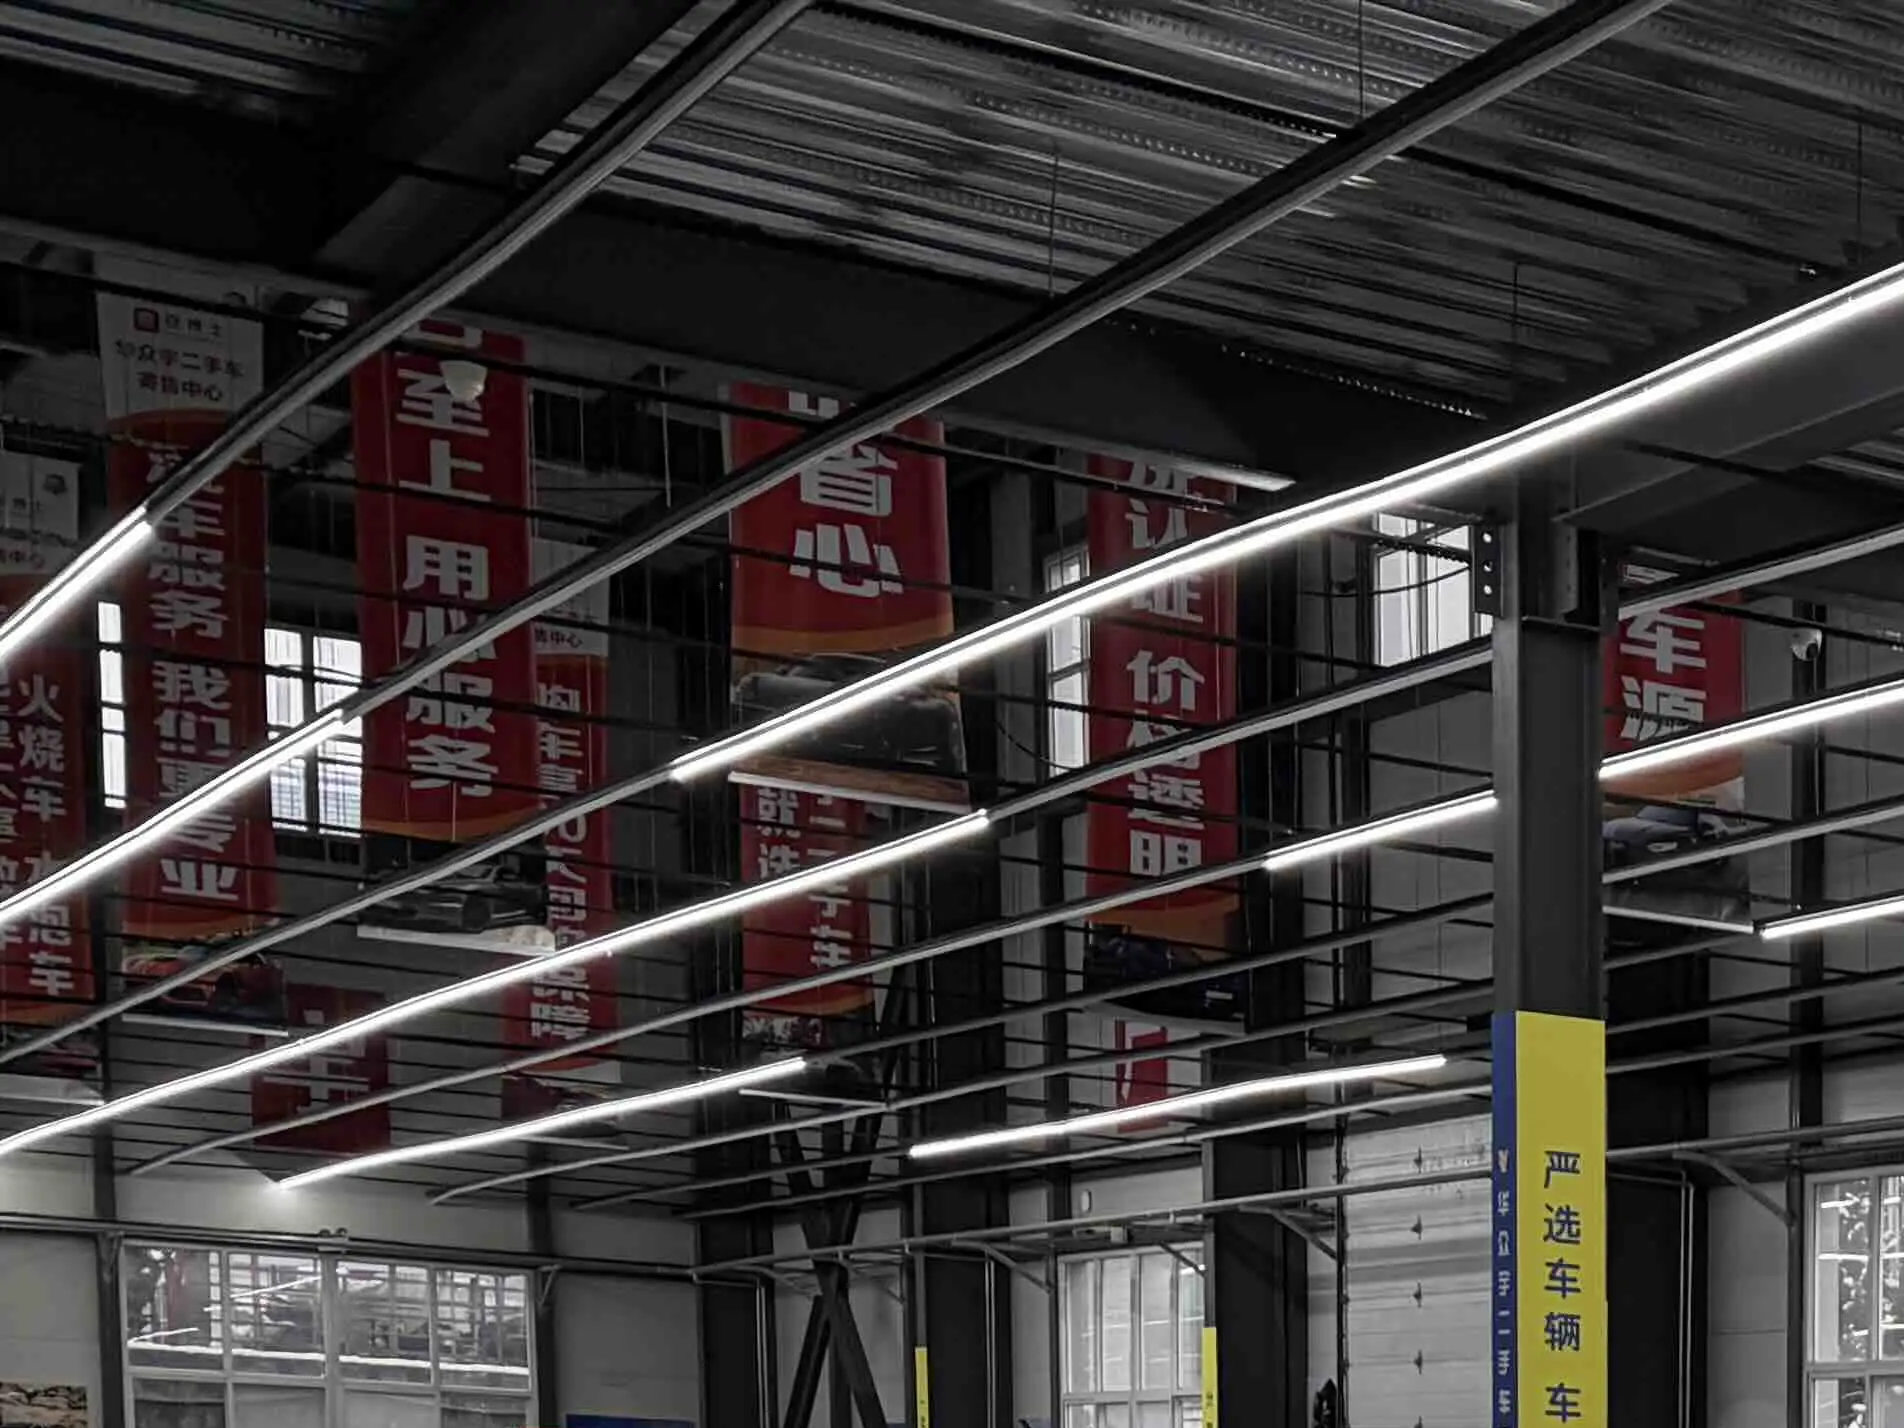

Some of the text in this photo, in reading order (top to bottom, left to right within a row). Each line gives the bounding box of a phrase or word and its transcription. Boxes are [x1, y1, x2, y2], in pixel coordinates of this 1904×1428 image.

[396, 318, 498, 798] 至上 用心服务
[17, 671, 67, 823] 火烧车
[1126, 648, 1205, 880] 价格透明
[1543, 1150, 1581, 1352] 严选车辆
